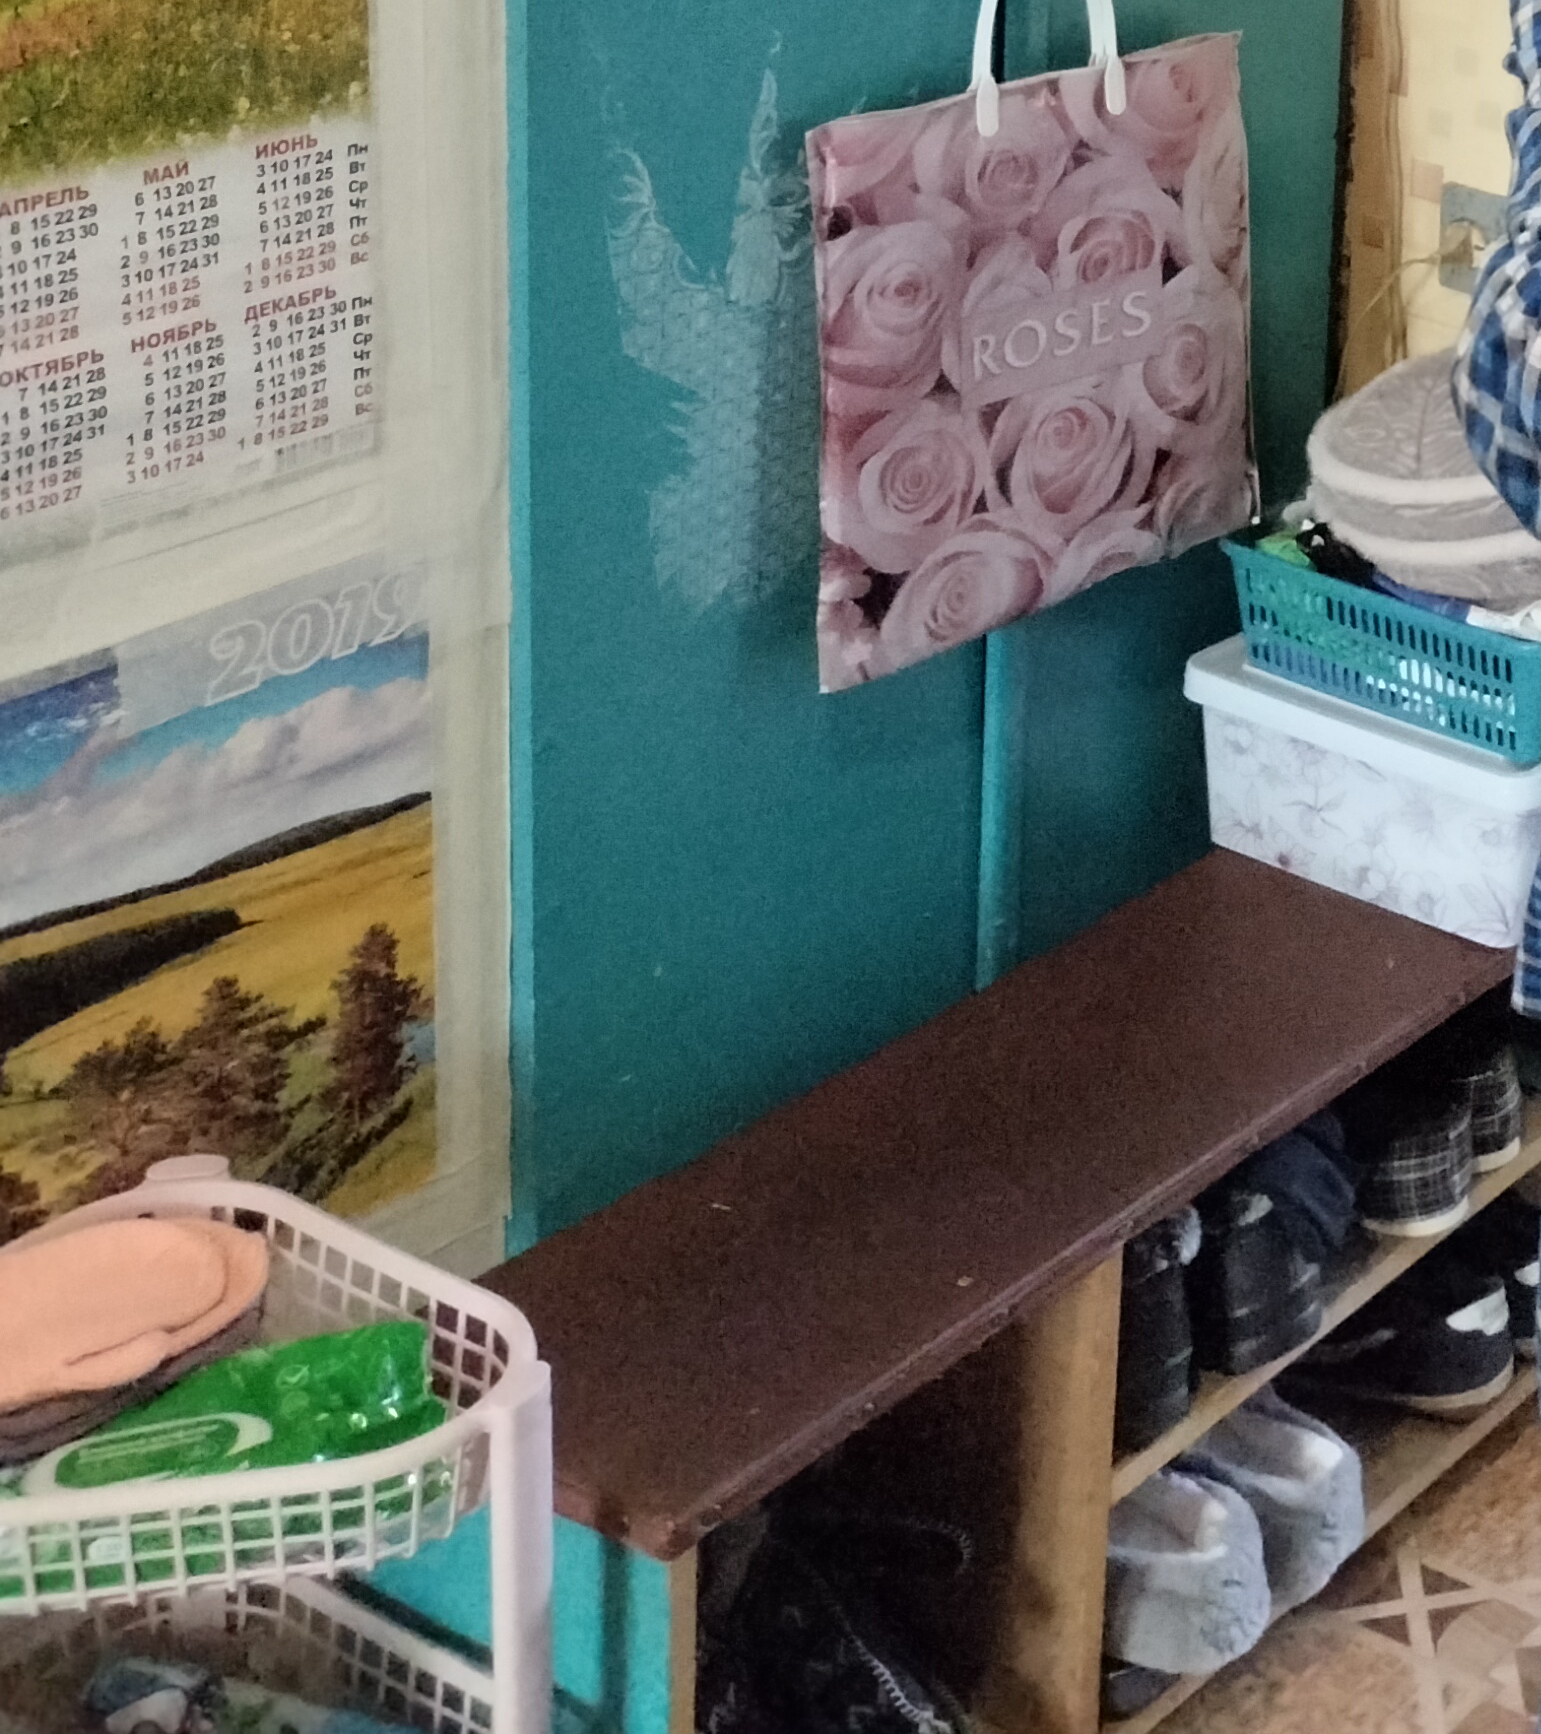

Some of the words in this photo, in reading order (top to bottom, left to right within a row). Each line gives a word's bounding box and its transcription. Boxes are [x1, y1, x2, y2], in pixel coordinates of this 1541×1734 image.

[255, 134, 318, 159] ИЮНЬ
[256, 164, 266, 178] 3
[270, 159, 289, 174] 10
[294, 154, 311, 169] 17
[315, 149, 333, 165] 24
[347, 143, 368, 157] Пн
[143, 159, 190, 185] МАЙ
[256, 182, 266, 194] 4
[271, 177, 287, 192] 11
[293, 172, 311, 186] 18
[315, 166, 333, 182] 25
[349, 161, 365, 174] Вт
[0, 185, 90, 217] АПРЕЛЬ
[135, 192, 144, 206] 6
[153, 186, 172, 202] 13
[176, 181, 194, 197] 20
[198, 175, 216, 192] 27
[258, 201, 267, 215] 5
[294, 191, 312, 206] 19
[316, 185, 334, 201] 26
[348, 180, 368, 194] Ср
[31, 214, 51, 230] 15
[55, 209, 74, 226] 22
[78, 203, 97, 220] 29
[135, 211, 145, 225] 7
[155, 205, 173, 221] 14
[177, 199, 194, 216] 21
[199, 194, 218, 211] 28
[260, 220, 269, 234] 6
[273, 214, 291, 230] 13
[295, 209, 313, 225] 20
[316, 203, 334, 220] 27
[349, 197, 366, 209] Чт
[31, 234, 51, 249] 16
[56, 228, 75, 244] 23
[79, 222, 99, 239] 30
[137, 231, 147, 245] 8
[156, 224, 176, 240] 15
[179, 219, 197, 236] 22
[201, 214, 219, 231] 29
[260, 238, 269, 253] 7
[274, 233, 292, 248] 14
[295, 227, 311, 244] 21
[317, 221, 335, 238] 28
[349, 215, 368, 229] Пт
[8, 260, 27, 276] 10
[33, 253, 52, 269] 17
[57, 248, 76, 265] 24
[120, 255, 130, 269] 2
[158, 244, 176, 259] 16
[180, 238, 198, 254] 23
[202, 233, 220, 249] 30
[10, 280, 28, 295] 11
[34, 273, 54, 289] 18
[58, 267, 78, 284] 25
[121, 274, 130, 288] 3
[135, 268, 153, 284] 10
[158, 262, 176, 278] 17
[180, 257, 198, 274] 24
[202, 251, 219, 267] 31
[10, 299, 29, 314] 12
[35, 293, 54, 309] 19
[59, 287, 78, 304] 26
[244, 285, 337, 325] ДЕКАБРЬ
[252, 324, 261, 338] 2
[269, 319, 278, 332] 9
[287, 311, 304, 327] 16
[307, 306, 325, 322] 23
[330, 300, 347, 316] 30
[352, 296, 372, 310] Пн
[131, 318, 217, 353] НОЯБРЬ
[162, 347, 179, 363] 11
[184, 340, 202, 356] 18
[206, 334, 224, 351] 25
[253, 342, 262, 355] 3
[266, 335, 282, 351] 10
[287, 329, 304, 345] 17
[308, 324, 325, 339] 24
[330, 317, 346, 333] 31
[354, 314, 370, 328] Вт
[972, 290, 1153, 382] ROSES
[0, 349, 105, 388] ОКТЯБРЬ
[145, 372, 154, 387] 5
[163, 365, 181, 381] 12
[186, 359, 203, 374] 19
[207, 353, 225, 369] 26
[254, 361, 263, 373] 4
[268, 354, 283, 370] 11
[289, 348, 305, 363] 18
[309, 342, 326, 358] 25
[353, 332, 373, 346] Ср
[38, 380, 58, 396] 14
[62, 373, 80, 390] 21
[86, 367, 106, 384] 28
[145, 392, 155, 406] 6
[164, 384, 182, 400] 13
[186, 378, 204, 395] 20
[209, 371, 226, 389] 27
[255, 397, 264, 410] 6
[270, 391, 286, 406] 13
[290, 384, 307, 401] 20
[311, 377, 327, 394] 27
[354, 367, 371, 380] Пт
[256, 379, 265, 393] 5
[269, 373, 285, 388] 12
[290, 366, 306, 381] 19
[310, 359, 326, 376] 26
[353, 349, 371, 361] Чт
[40, 398, 59, 415] 15
[64, 392, 83, 409] 22
[87, 386, 107, 403] 29
[145, 410, 154, 424] 7
[164, 403, 182, 418] 14
[185, 396, 202, 413] 21
[208, 390, 226, 406] 28
[20, 426, 31, 441] 9
[41, 419, 60, 434] 16
[64, 412, 84, 429] 23
[88, 405, 108, 422] 30
[127, 433, 134, 446] 1
[143, 428, 153, 441] 8
[163, 420, 182, 436] 15
[186, 414, 204, 431] 22
[207, 408, 226, 424] 29
[15, 444, 35, 459] 10
[41, 436, 59, 452] 17
[63, 430, 82, 447] 24
[87, 424, 105, 439] 31
[15, 462, 33, 478] 11
[39, 455, 58, 471] 18
[63, 448, 83, 465] 25
